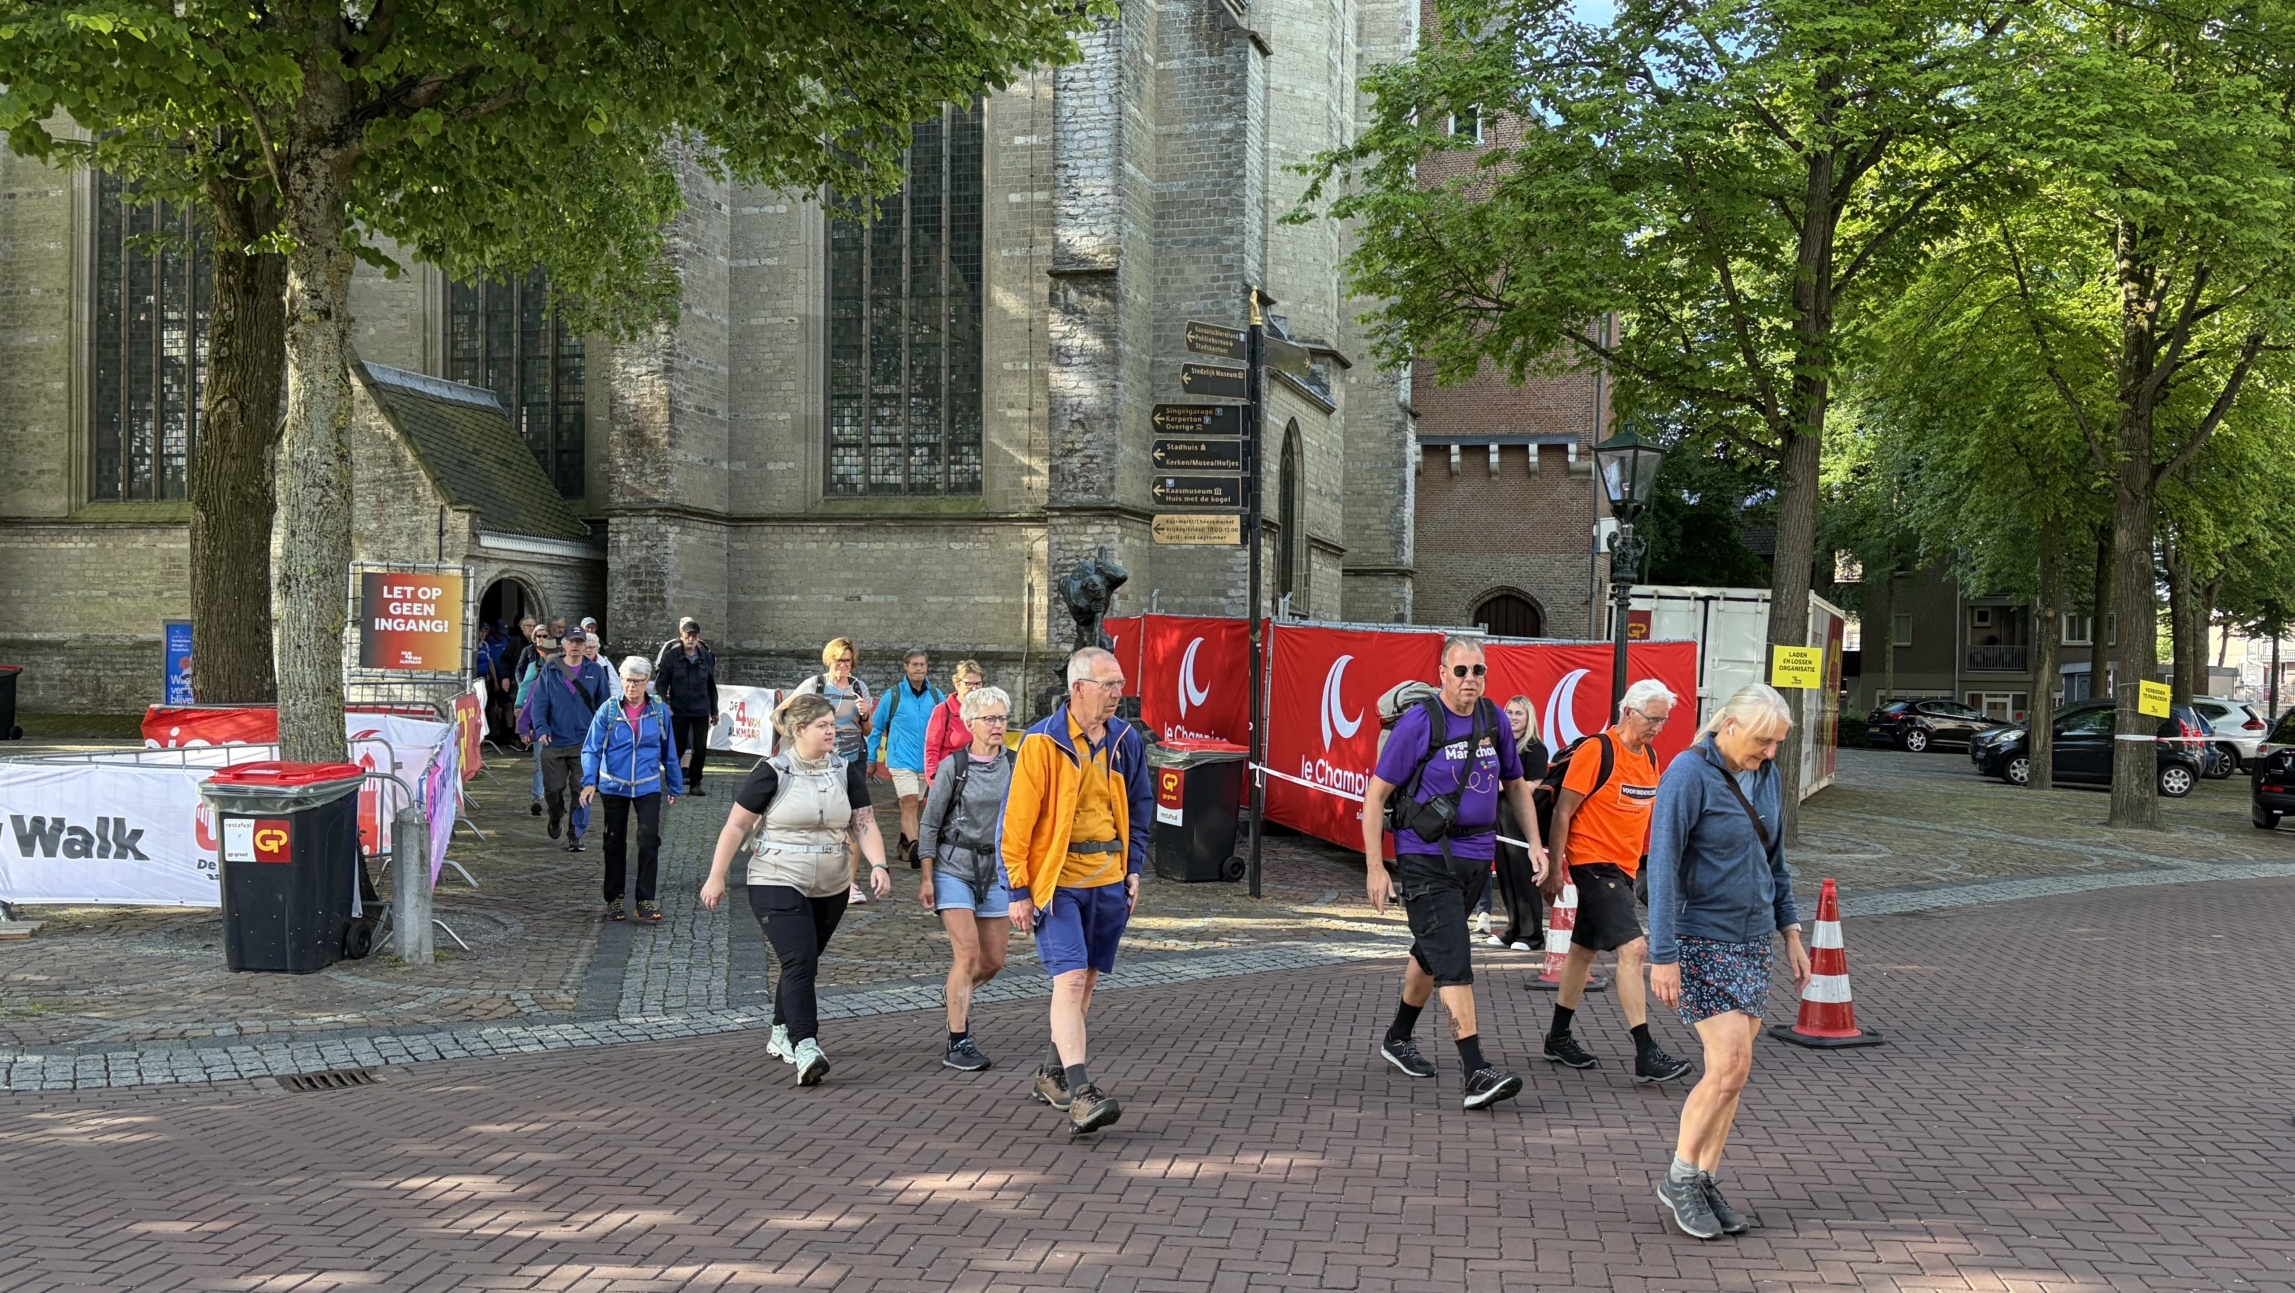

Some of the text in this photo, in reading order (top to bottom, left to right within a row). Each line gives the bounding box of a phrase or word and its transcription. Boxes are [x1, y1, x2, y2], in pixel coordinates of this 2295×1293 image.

[1191, 367, 1237, 378] Stedelijk Museum
[1166, 459, 1239, 467] Kerken/Musea/Hofjes
[383, 586, 442, 599] LET OP
[389, 602, 435, 616] GEEN
[374, 618, 449, 632] INGANG!
[730, 701, 738, 711] DE
[736, 702, 746, 726] 4
[1301, 754, 1369, 796] le Champi
[10, 815, 150, 860] Walk
[255, 829, 288, 853] GP
[197, 859, 216, 870] De
